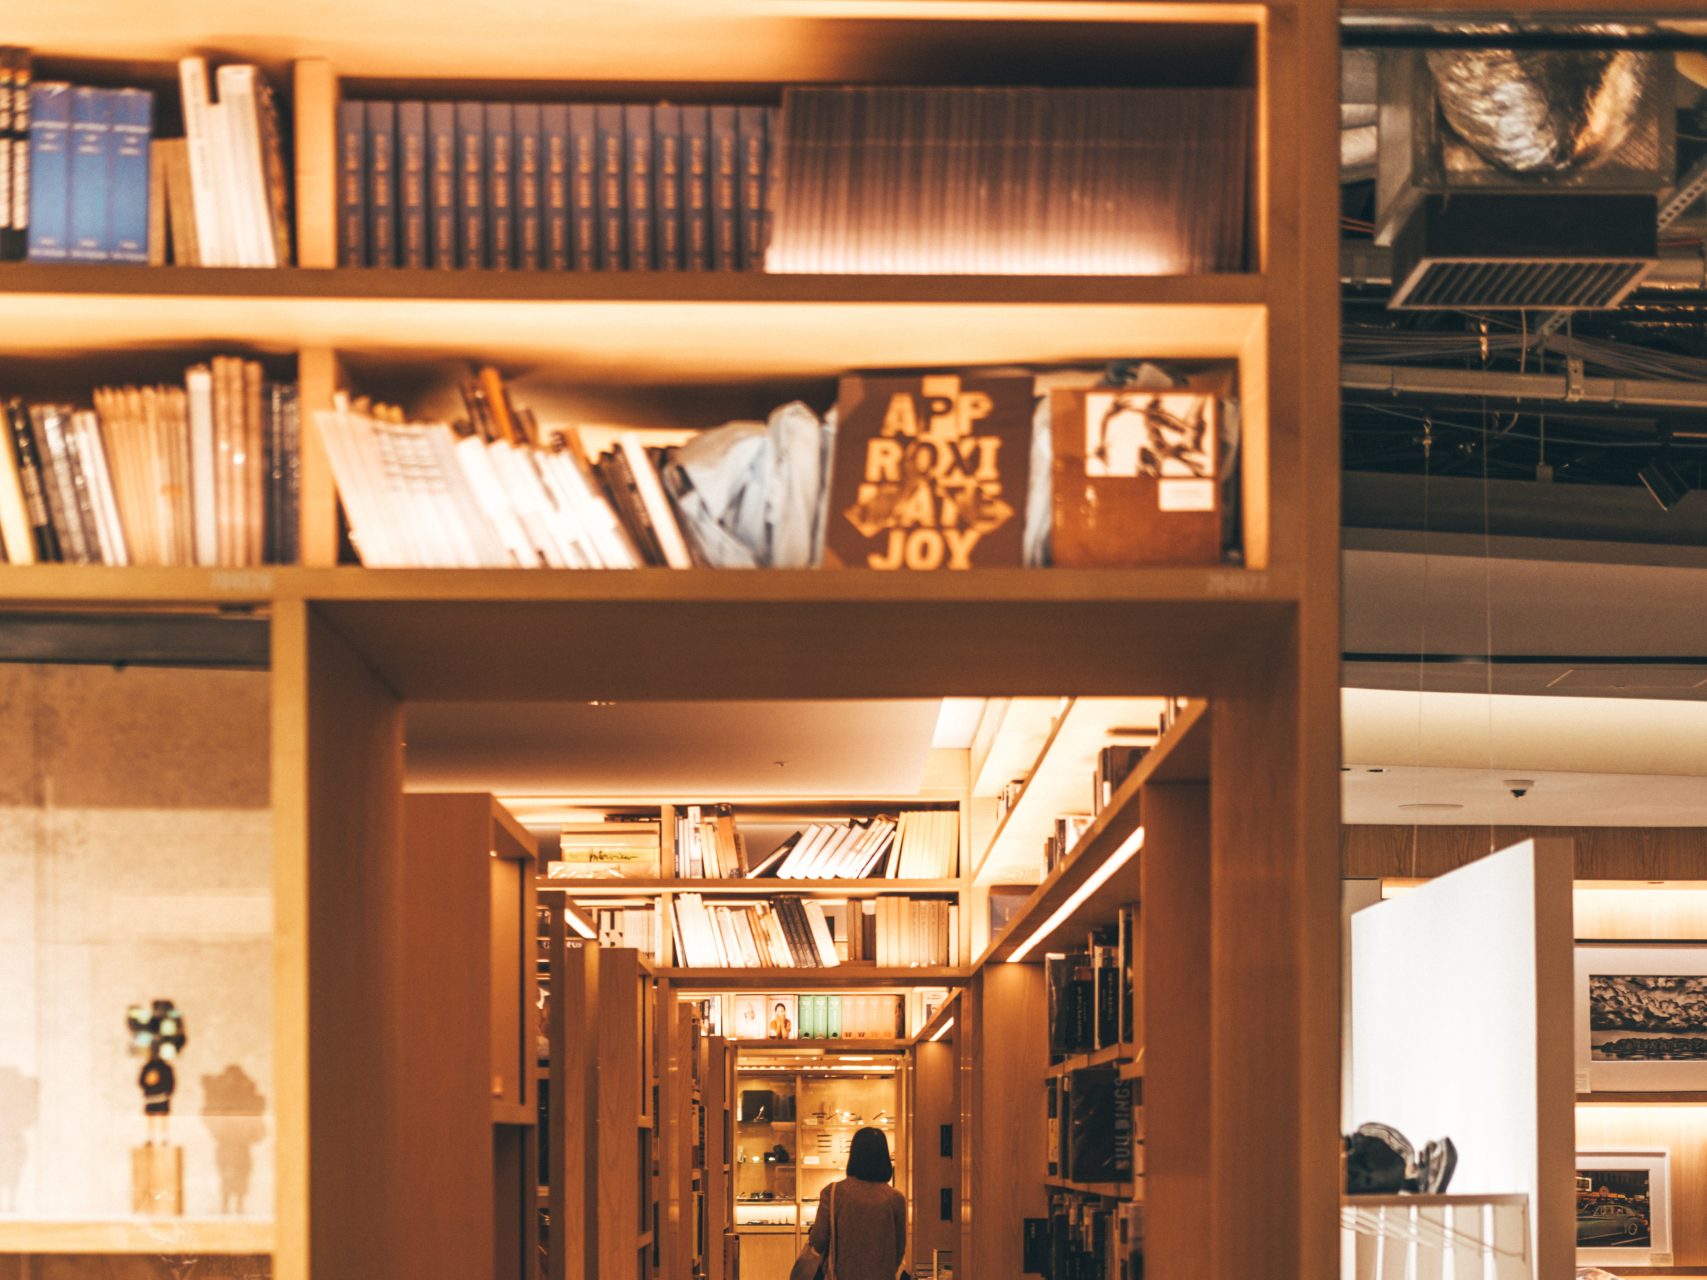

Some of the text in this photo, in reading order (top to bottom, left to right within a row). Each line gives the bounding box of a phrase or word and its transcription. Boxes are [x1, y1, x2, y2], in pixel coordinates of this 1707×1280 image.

[880, 391, 993, 438] APP
[865, 436, 1002, 482] ROXI
[866, 528, 983, 570] JOY
